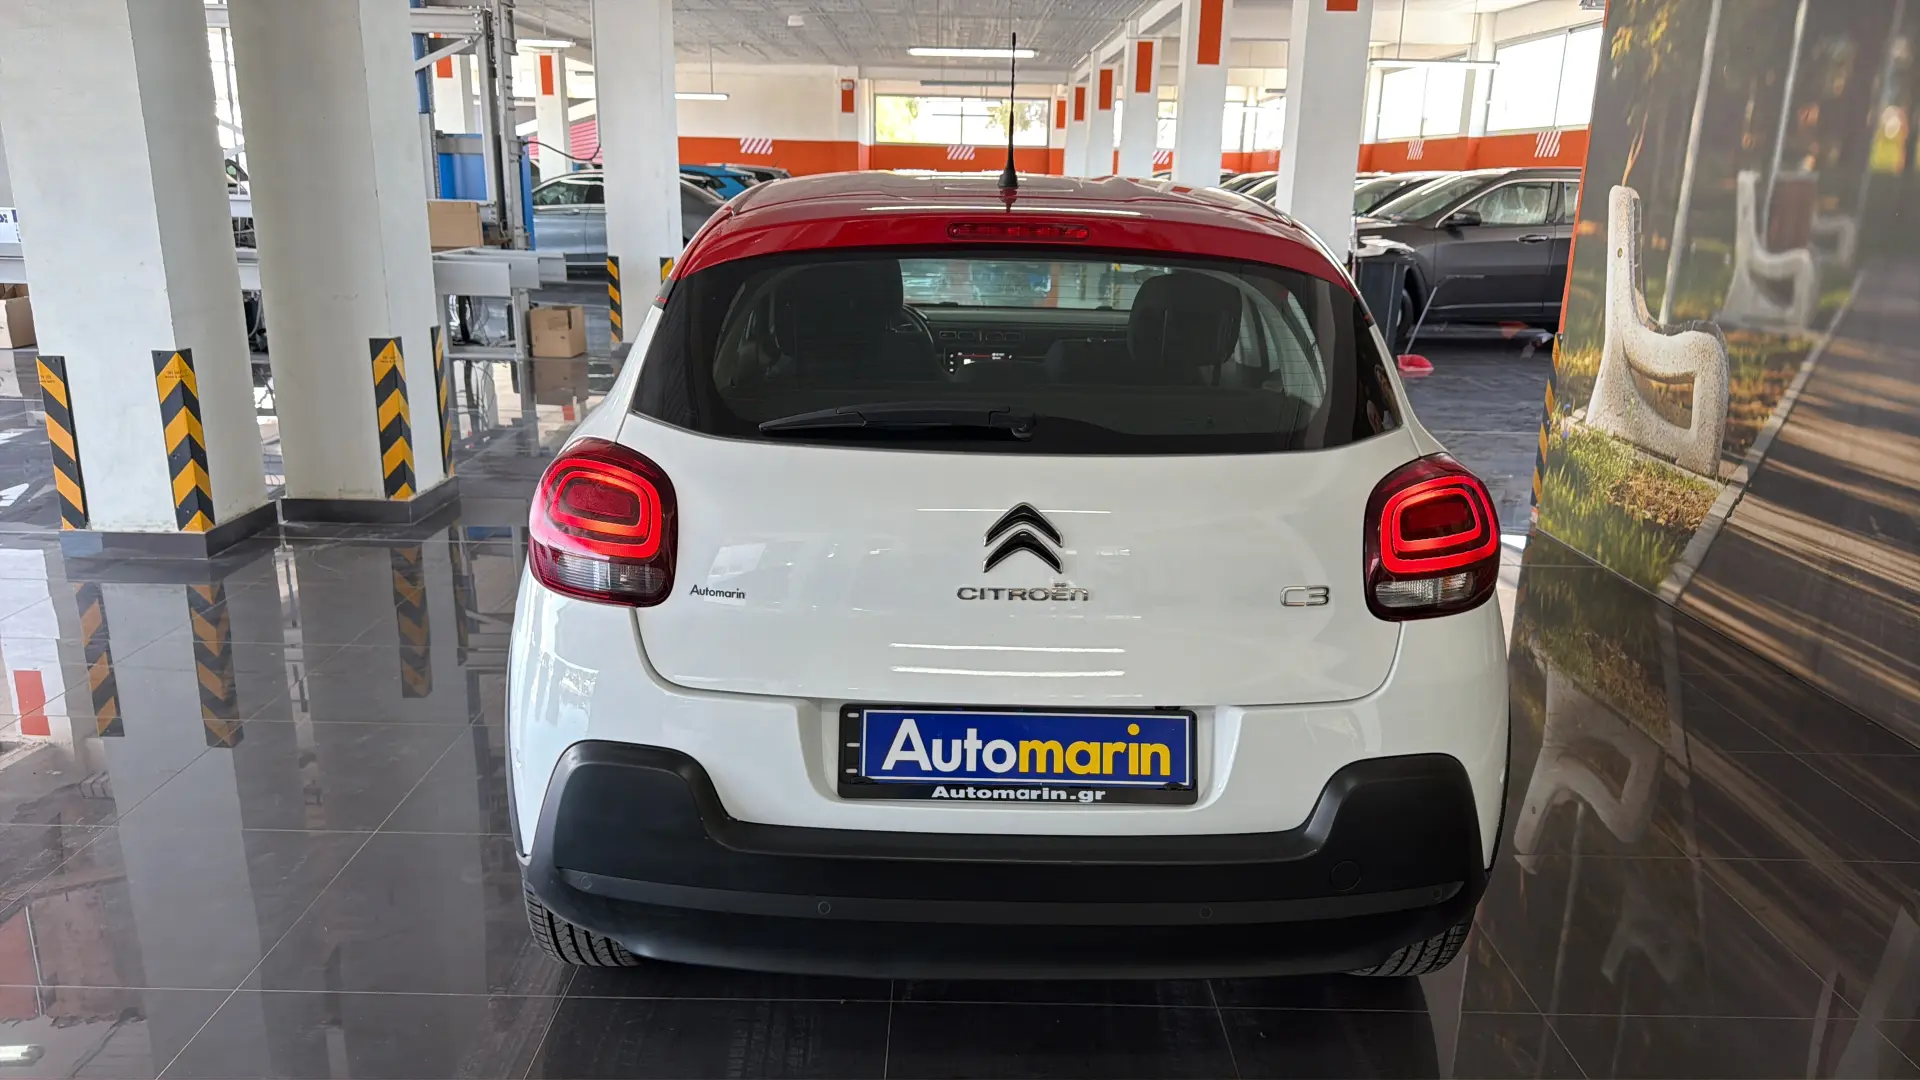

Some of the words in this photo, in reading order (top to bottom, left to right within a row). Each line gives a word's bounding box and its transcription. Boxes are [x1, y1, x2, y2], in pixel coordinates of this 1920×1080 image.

[689, 584, 746, 599] Automarin
[1280, 585, 1330, 606] C3
[881, 718, 1171, 776] Automarin
[931, 785, 1107, 803] Automarin.gr
